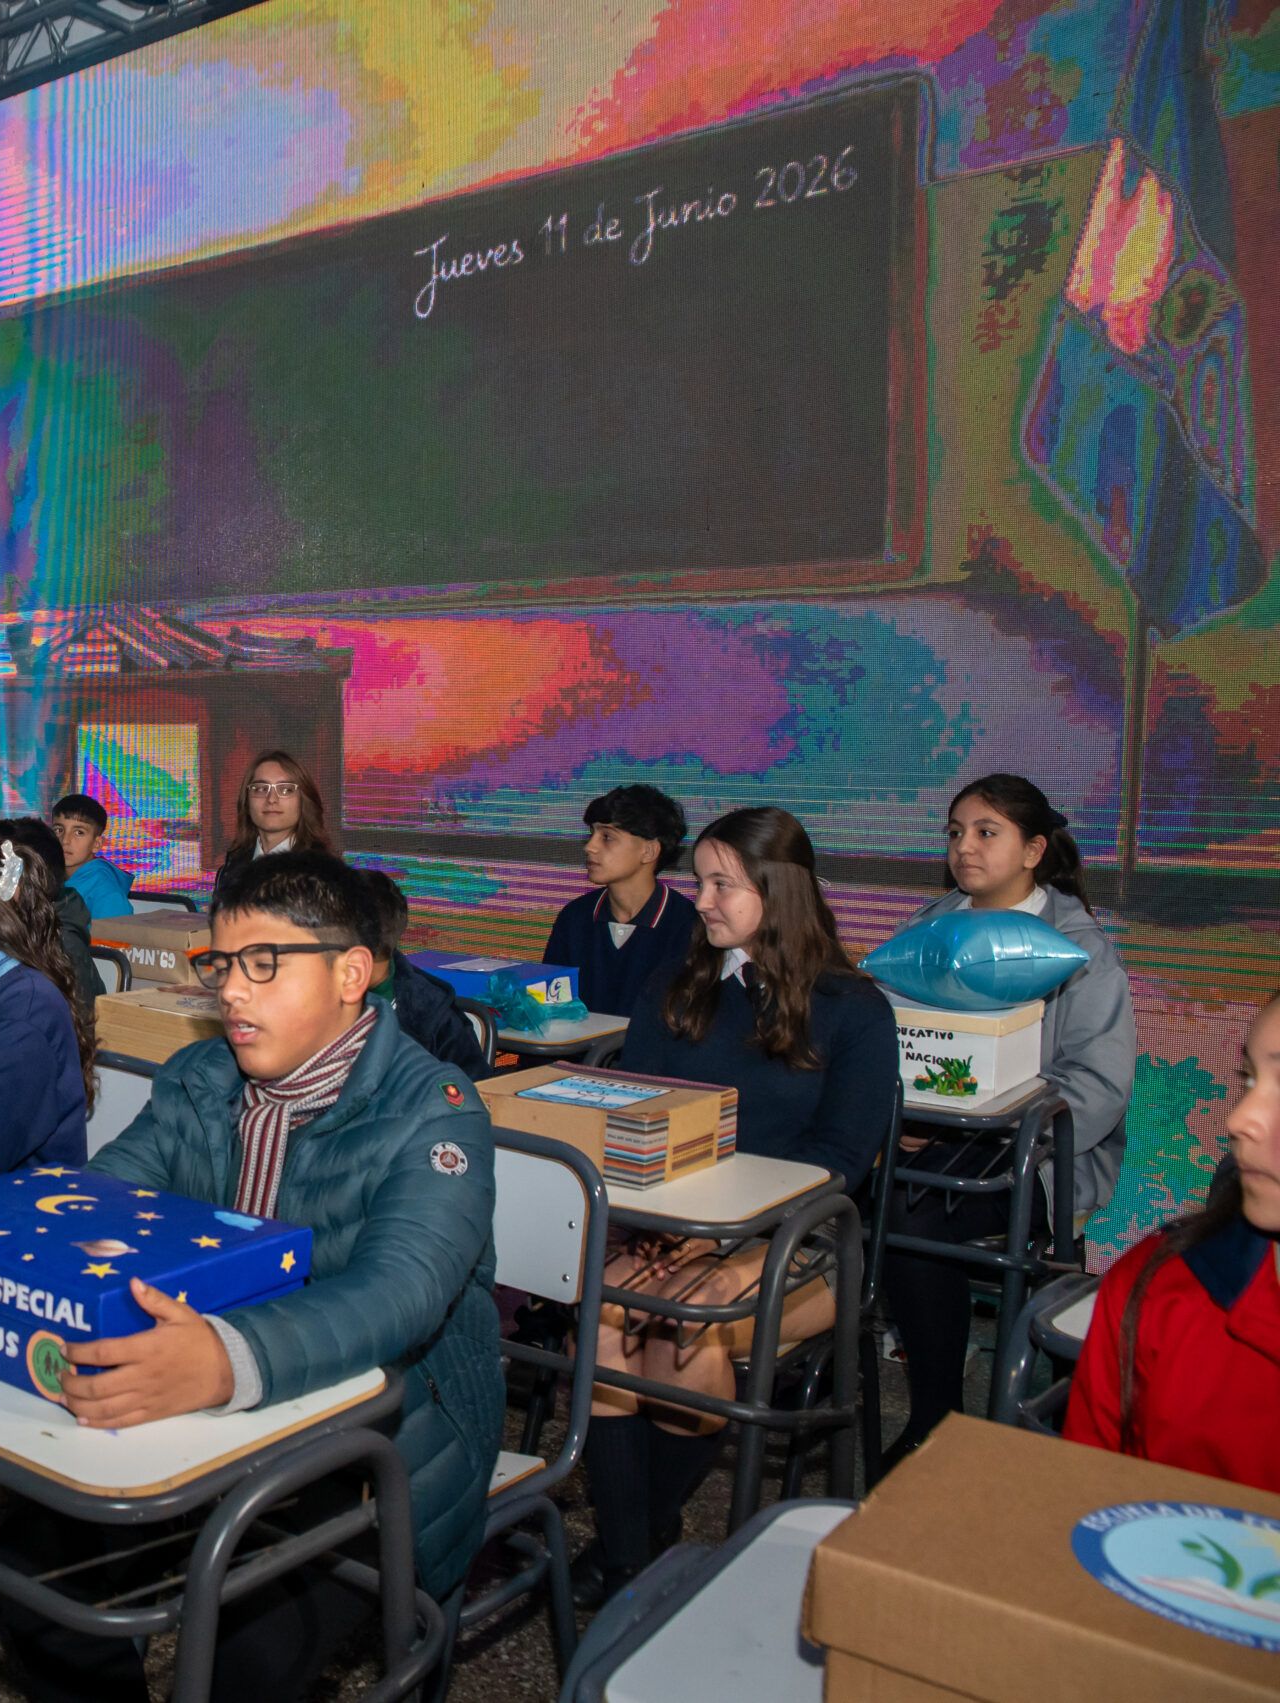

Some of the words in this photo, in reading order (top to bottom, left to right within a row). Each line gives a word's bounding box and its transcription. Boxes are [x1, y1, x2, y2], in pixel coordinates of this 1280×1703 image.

[414, 232, 524, 318] Jueves
[538, 211, 568, 256] 11
[583, 202, 622, 246] de
[630, 186, 738, 264] Junio
[753, 144, 858, 209] 2026
